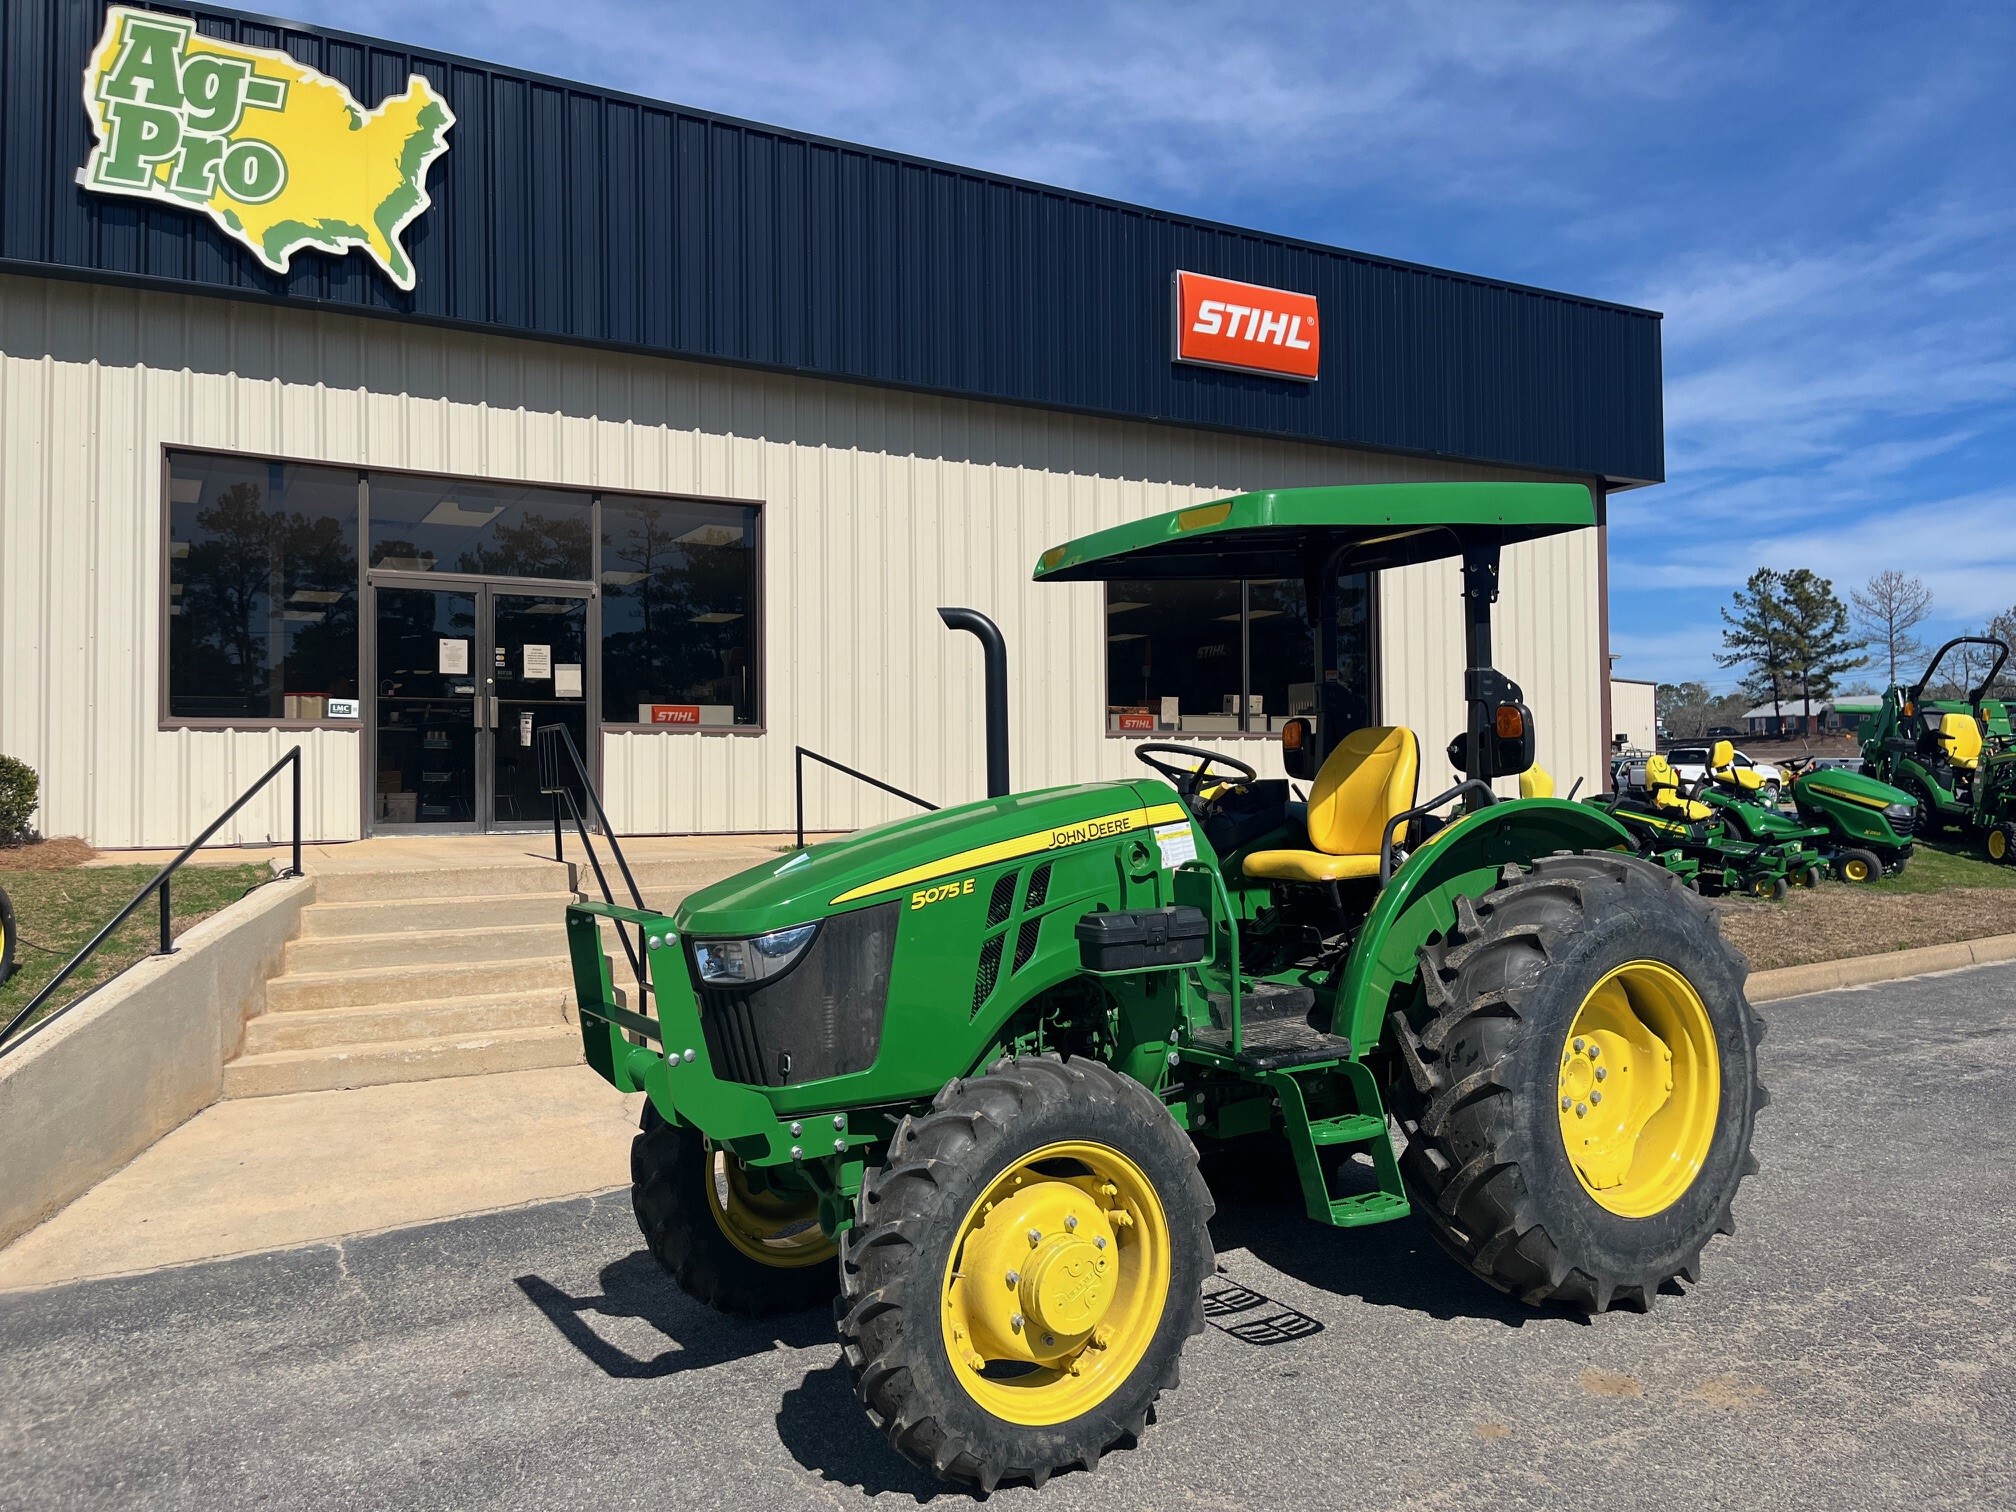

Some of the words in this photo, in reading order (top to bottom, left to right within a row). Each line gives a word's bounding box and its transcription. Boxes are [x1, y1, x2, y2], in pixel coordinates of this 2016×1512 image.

[103, 19, 286, 132] Ag-
[101, 104, 286, 201] Pro
[1193, 299, 1311, 350] STIHL
[332, 704, 350, 712] LMC
[656, 711, 696, 722] STIHL
[1124, 719, 1152, 729] STIHL
[1048, 831, 1087, 848] JOHN
[1088, 817, 1131, 838] DEERE
[911, 881, 961, 910] 5075
